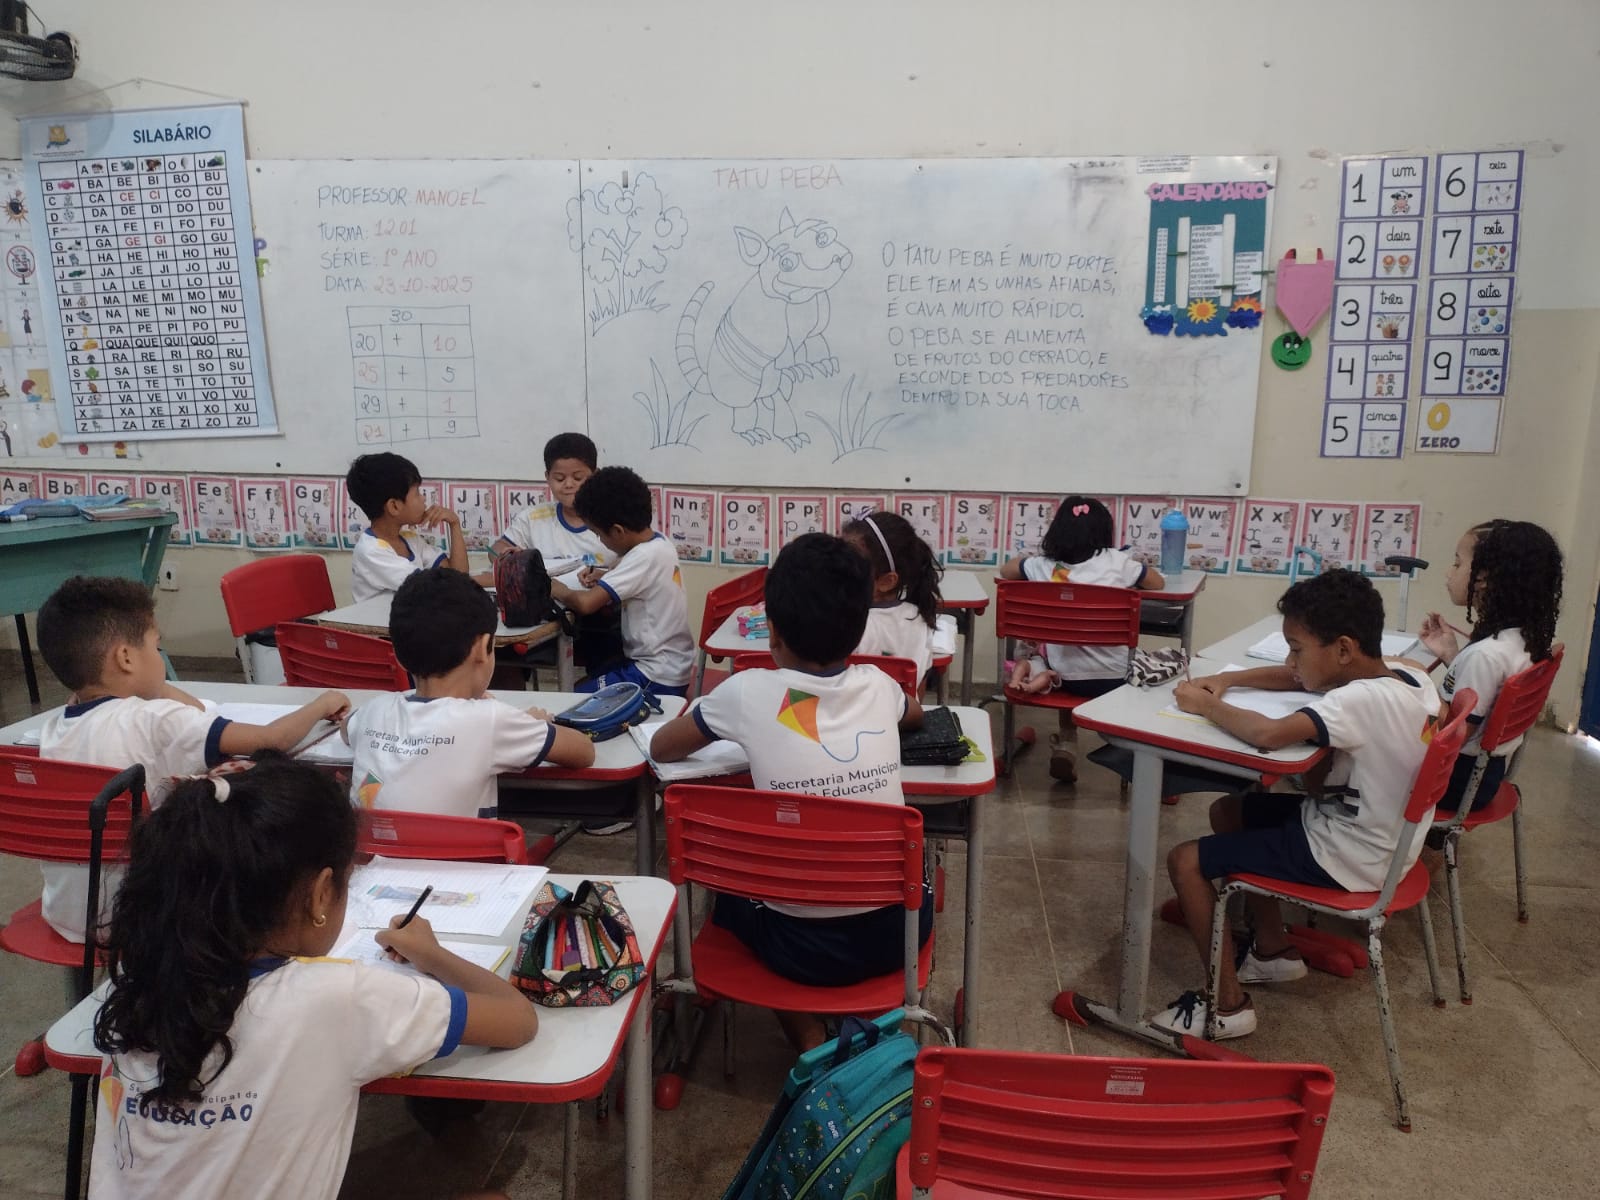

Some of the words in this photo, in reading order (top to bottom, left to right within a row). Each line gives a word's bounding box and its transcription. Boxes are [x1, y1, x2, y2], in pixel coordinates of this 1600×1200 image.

[133, 123, 211, 143] SILABÁRIO
[81, 165, 88, 174] A
[112, 163, 118, 171] E
[141, 162, 143, 170] I
[168, 161, 176, 170] O
[199, 160, 205, 168] U
[712, 168, 768, 190] TATU
[780, 163, 843, 190] PEBA
[46, 183, 53, 191] B
[88, 180, 103, 188] BA
[118, 178, 132, 186] BE
[148, 176, 159, 185] BI
[174, 174, 189, 183] BO
[205, 172, 220, 181] BU
[1352, 174, 1366, 203] 1
[1392, 167, 1416, 177] um
[1446, 167, 1465, 197] 6
[49, 197, 56, 206] C
[89, 194, 104, 203] CA
[120, 192, 134, 201] CE
[150, 191, 160, 199] CI
[175, 189, 191, 197] CO
[207, 187, 222, 195] CU
[318, 185, 408, 208] PROFESSOR
[416, 188, 486, 207] MANOEL
[51, 213, 58, 221] D
[92, 209, 107, 217] DA
[121, 207, 136, 215] DE
[151, 205, 162, 213] DI
[177, 204, 193, 212] DO
[208, 202, 223, 210] DU
[53, 228, 59, 236] F
[95, 225, 109, 233] FA
[124, 223, 137, 231] FE
[154, 221, 163, 230] FI
[180, 219, 194, 228] FO
[211, 218, 224, 226] FU
[55, 242, 63, 251] G
[96, 239, 112, 248] GA
[126, 237, 140, 246] GE
[155, 235, 165, 244] GI
[181, 234, 197, 243] GO
[211, 233, 227, 241] GU
[1348, 235, 1365, 264] 2
[1443, 229, 1462, 259] 7
[403, 249, 437, 269] ANO
[882, 241, 895, 267] O
[904, 243, 940, 266] TATU
[949, 248, 993, 266] PEBA
[1000, 244, 1011, 266] É
[1019, 252, 1062, 269] MUITO
[887, 274, 921, 292] ELE
[928, 275, 960, 293] TEM
[967, 277, 988, 292] AS
[996, 276, 1042, 289] UNHAS
[1049, 275, 1115, 295] AFIADAS,
[906, 301, 945, 317] CAVA
[952, 301, 1002, 318] MUITO
[1437, 292, 1456, 320] 8
[1478, 282, 1502, 298] oito
[390, 310, 412, 322] 30
[1341, 299, 1359, 326] 3
[110, 326, 123, 334] PA
[138, 324, 152, 332] PE
[168, 323, 177, 331] PI
[193, 322, 208, 330] PO
[224, 320, 238, 329] PU
[356, 333, 375, 351] 20
[434, 335, 456, 351] 10
[889, 327, 904, 347] O
[910, 328, 963, 348] PEBA
[970, 330, 994, 345] SE
[1005, 328, 1085, 345] ALIMENTA
[895, 353, 917, 366] DE
[924, 352, 981, 366] FRUTOS
[990, 351, 1014, 366] DO
[1098, 353, 1108, 365] E
[1338, 358, 1354, 385] 4
[1372, 351, 1403, 365] quatro
[1434, 352, 1451, 380] 9
[74, 369, 80, 377] S
[115, 367, 129, 375] SA
[144, 365, 158, 374] SE
[173, 364, 182, 373] SI
[198, 363, 214, 371] SO
[230, 362, 244, 370] SU
[359, 362, 377, 383] 25
[442, 367, 455, 383] 5
[899, 370, 975, 385] ESCONDE
[979, 372, 1014, 385] DOS
[1022, 372, 1128, 388] PREDADORES
[361, 395, 380, 413] 29
[443, 397, 456, 413] 1
[966, 391, 989, 406] DA
[999, 392, 1029, 407] SUA
[1427, 402, 1450, 430] 0
[445, 420, 456, 433] 9
[1331, 416, 1348, 442] 5
[1366, 412, 1398, 421] cinco
[1420, 437, 1460, 448] ZERO
[770, 774, 843, 790] Secretaria
[848, 762, 898, 781] Municipa
[823, 779, 887, 797] Educação
[245, 1091, 258, 1099] da
